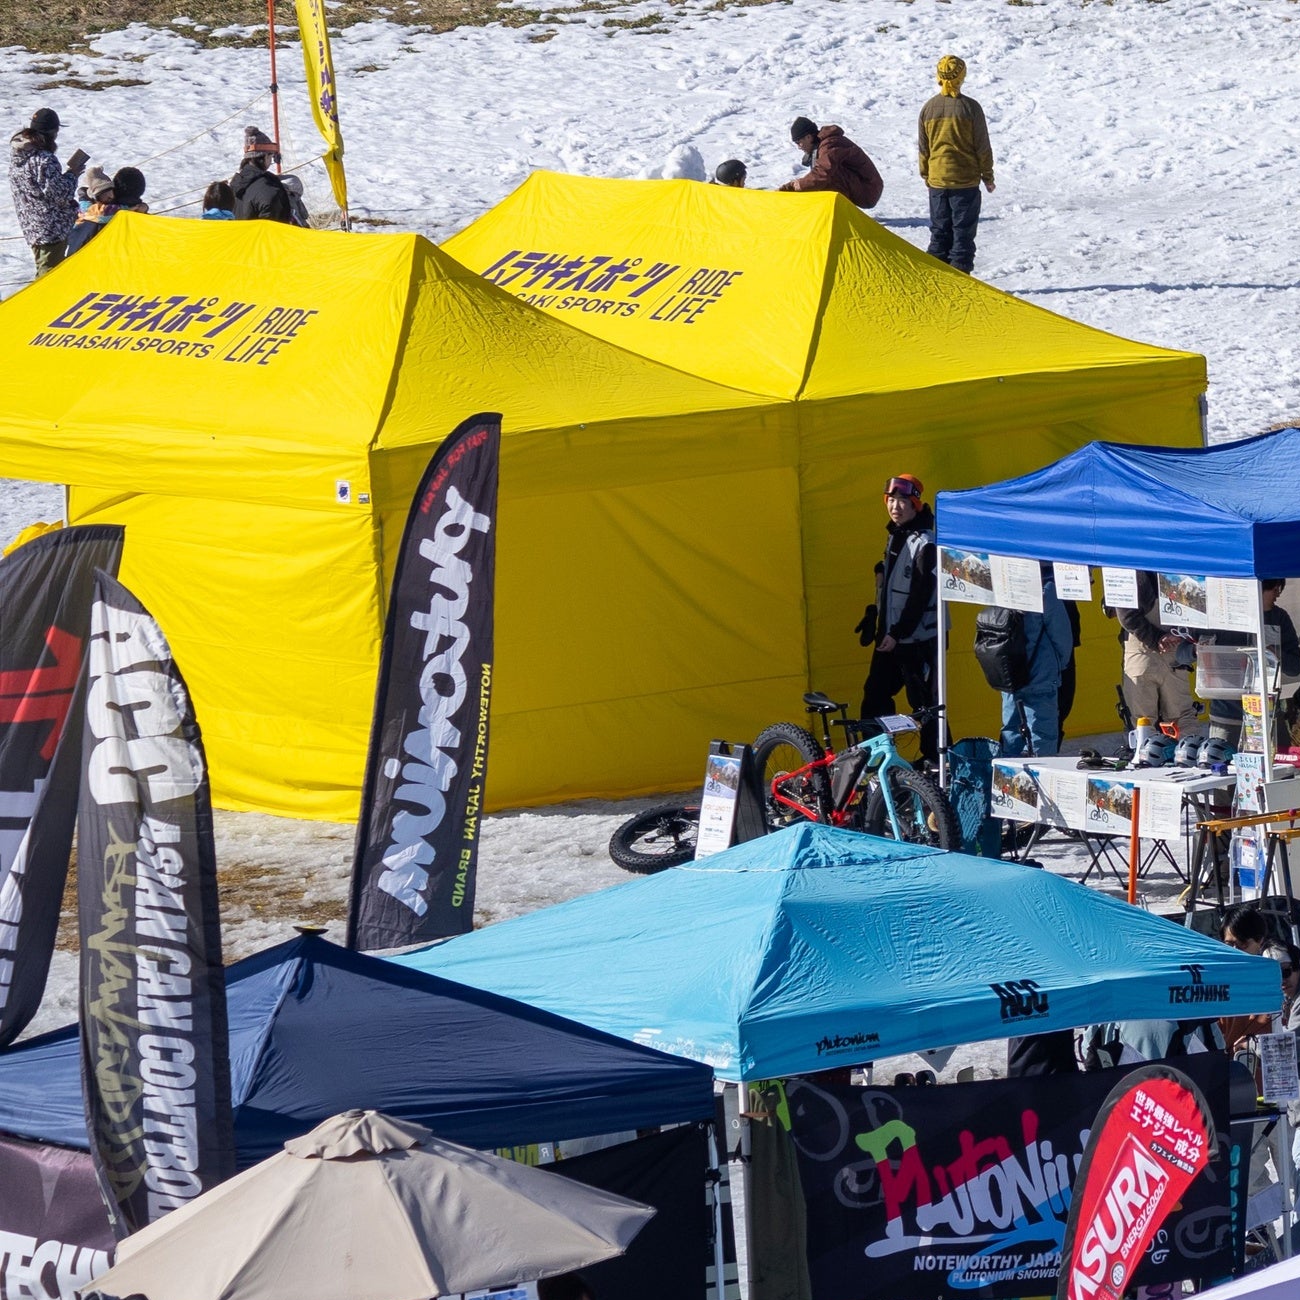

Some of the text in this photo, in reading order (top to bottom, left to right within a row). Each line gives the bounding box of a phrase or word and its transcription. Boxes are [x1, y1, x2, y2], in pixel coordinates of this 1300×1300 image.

[481, 250, 681, 298] ムラサキスポーツ
[677, 268, 743, 298] RIDE
[47, 292, 256, 338] ムラサキスポーツ
[557, 296, 640, 317] SPORTS
[649, 295, 716, 324] LIFE
[252, 307, 319, 337] RIDE
[29, 332, 215, 358] MURASAKI SPORTS
[224, 335, 291, 365] LIFE
[87, 601, 203, 804] ACC
[136, 816, 196, 1031] ASIAN CAN
[990, 979, 1050, 1019] ACC
[1168, 983, 1230, 1004] TECHNINE
[816, 1032, 880, 1056] plutonium
[1135, 1090, 1204, 1147] 世界最強レベル
[1129, 1106, 1201, 1164] エナジー成分
[1119, 1180, 1165, 1260] ENERGY 6000
[913, 1253, 1063, 1271] NOTEWORTHY JAPA
[951, 1267, 1061, 1283] PLUTONIUM SNOWBO
